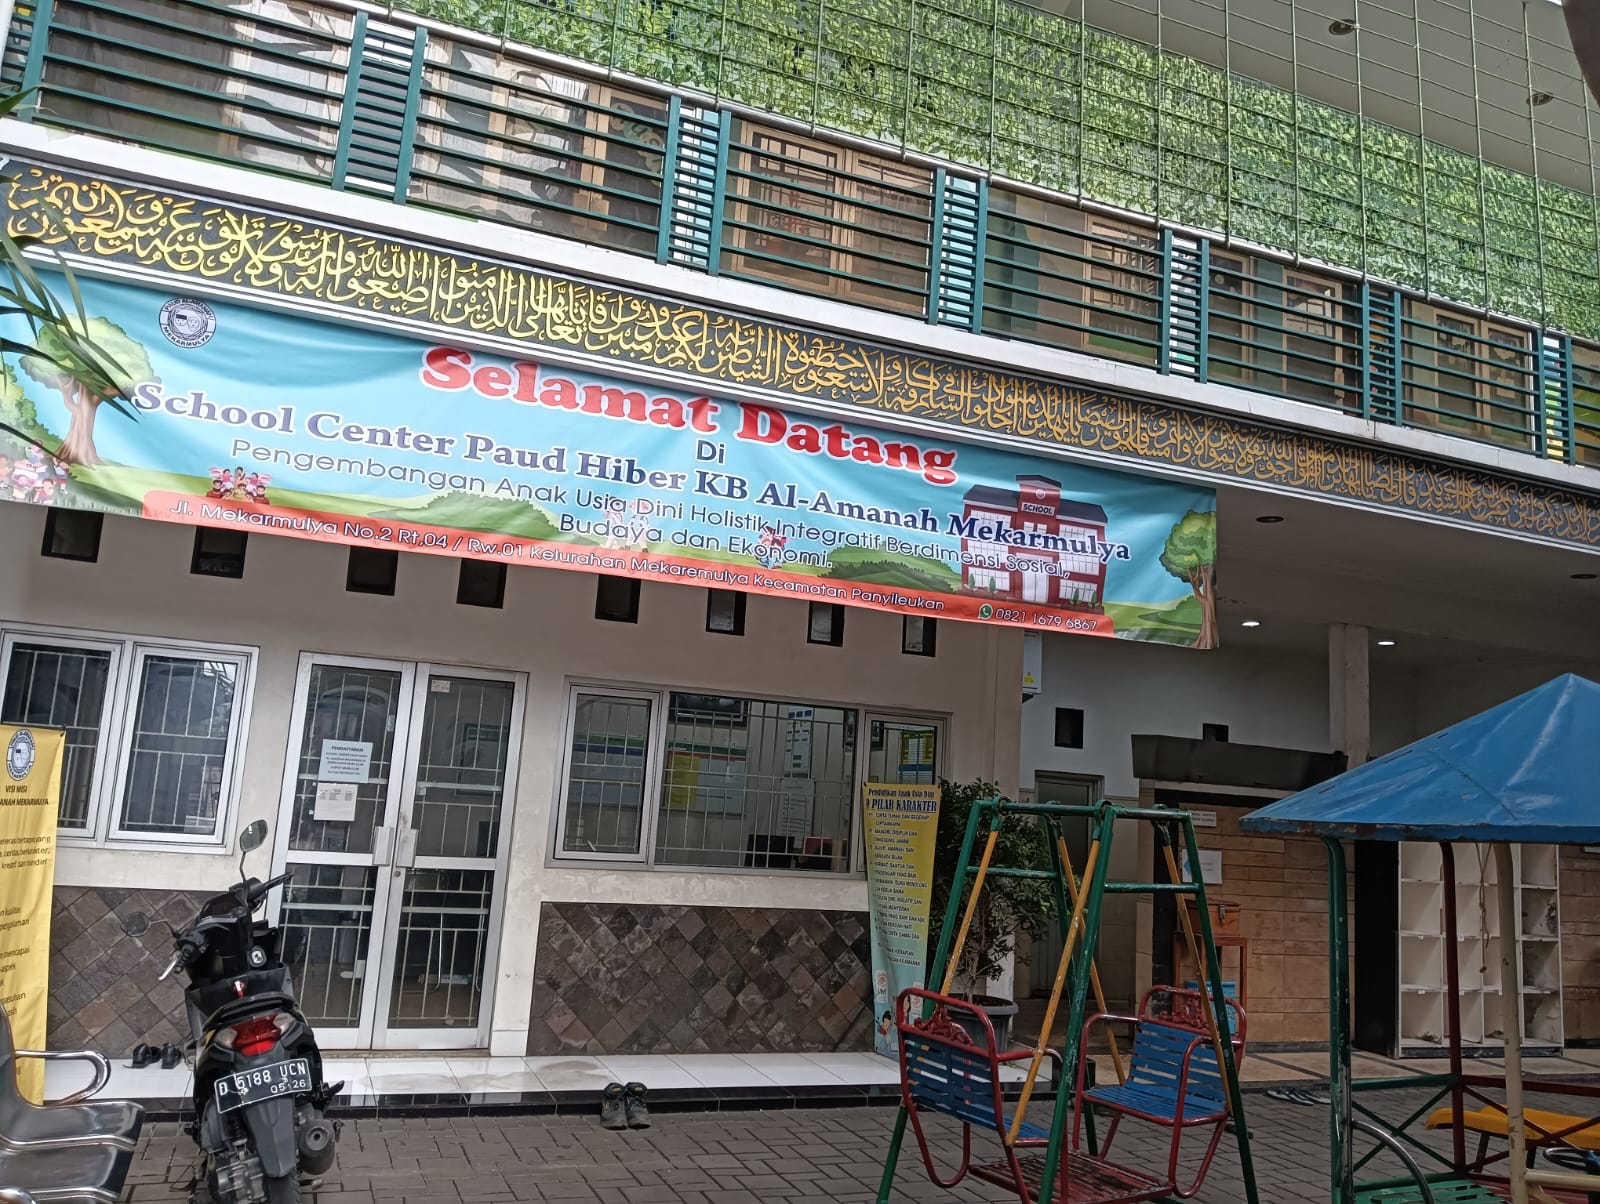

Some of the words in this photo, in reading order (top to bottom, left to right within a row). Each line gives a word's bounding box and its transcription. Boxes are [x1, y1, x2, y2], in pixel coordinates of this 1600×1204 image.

[422, 346, 720, 433] Selamat
[736, 401, 958, 485] Datang
[696, 439, 725, 464] Di
[134, 383, 293, 433] School
[307, 412, 455, 456] Center
[464, 434, 566, 474] Paud
[577, 451, 687, 491] Hiber
[694, 470, 749, 500] KB
[755, 482, 940, 533] Al-Amanah
[949, 513, 1131, 563] Mekarmulya
[232, 438, 486, 493] Pengembangan
[494, 477, 567, 505] Anak
[576, 488, 628, 514] Usia
[636, 497, 684, 520] Dini
[690, 504, 770, 533] Holistik
[776, 519, 882, 550] Integratif
[887, 536, 1001, 568] Berdimensi
[1006, 555, 1071, 579] Sosial,
[1022, 502, 1056, 516] SCHOOL
[559, 512, 663, 545] Budaya
[670, 528, 720, 552] dan
[200, 504, 338, 536] Mekarmulya
[343, 521, 394, 543] No.2
[467, 538, 523, 558] Rw.01
[529, 545, 626, 571] Kelurahan
[630, 557, 749, 586] Mekaremulya
[753, 573, 848, 598] Kecamatan
[851, 587, 945, 611] Panyileukan
[995, 607, 1026, 623] 0821
[1032, 612, 1062, 628] 1679
[1065, 616, 1098, 632] 6867
[868, 788, 897, 798] Pendidikan
[871, 798, 894, 811] PILAR
[896, 799, 937, 812] KARAKTER
[218, 1082, 229, 1097] D
[236, 1070, 272, 1089] 5188
[279, 1062, 306, 1078] UCN
